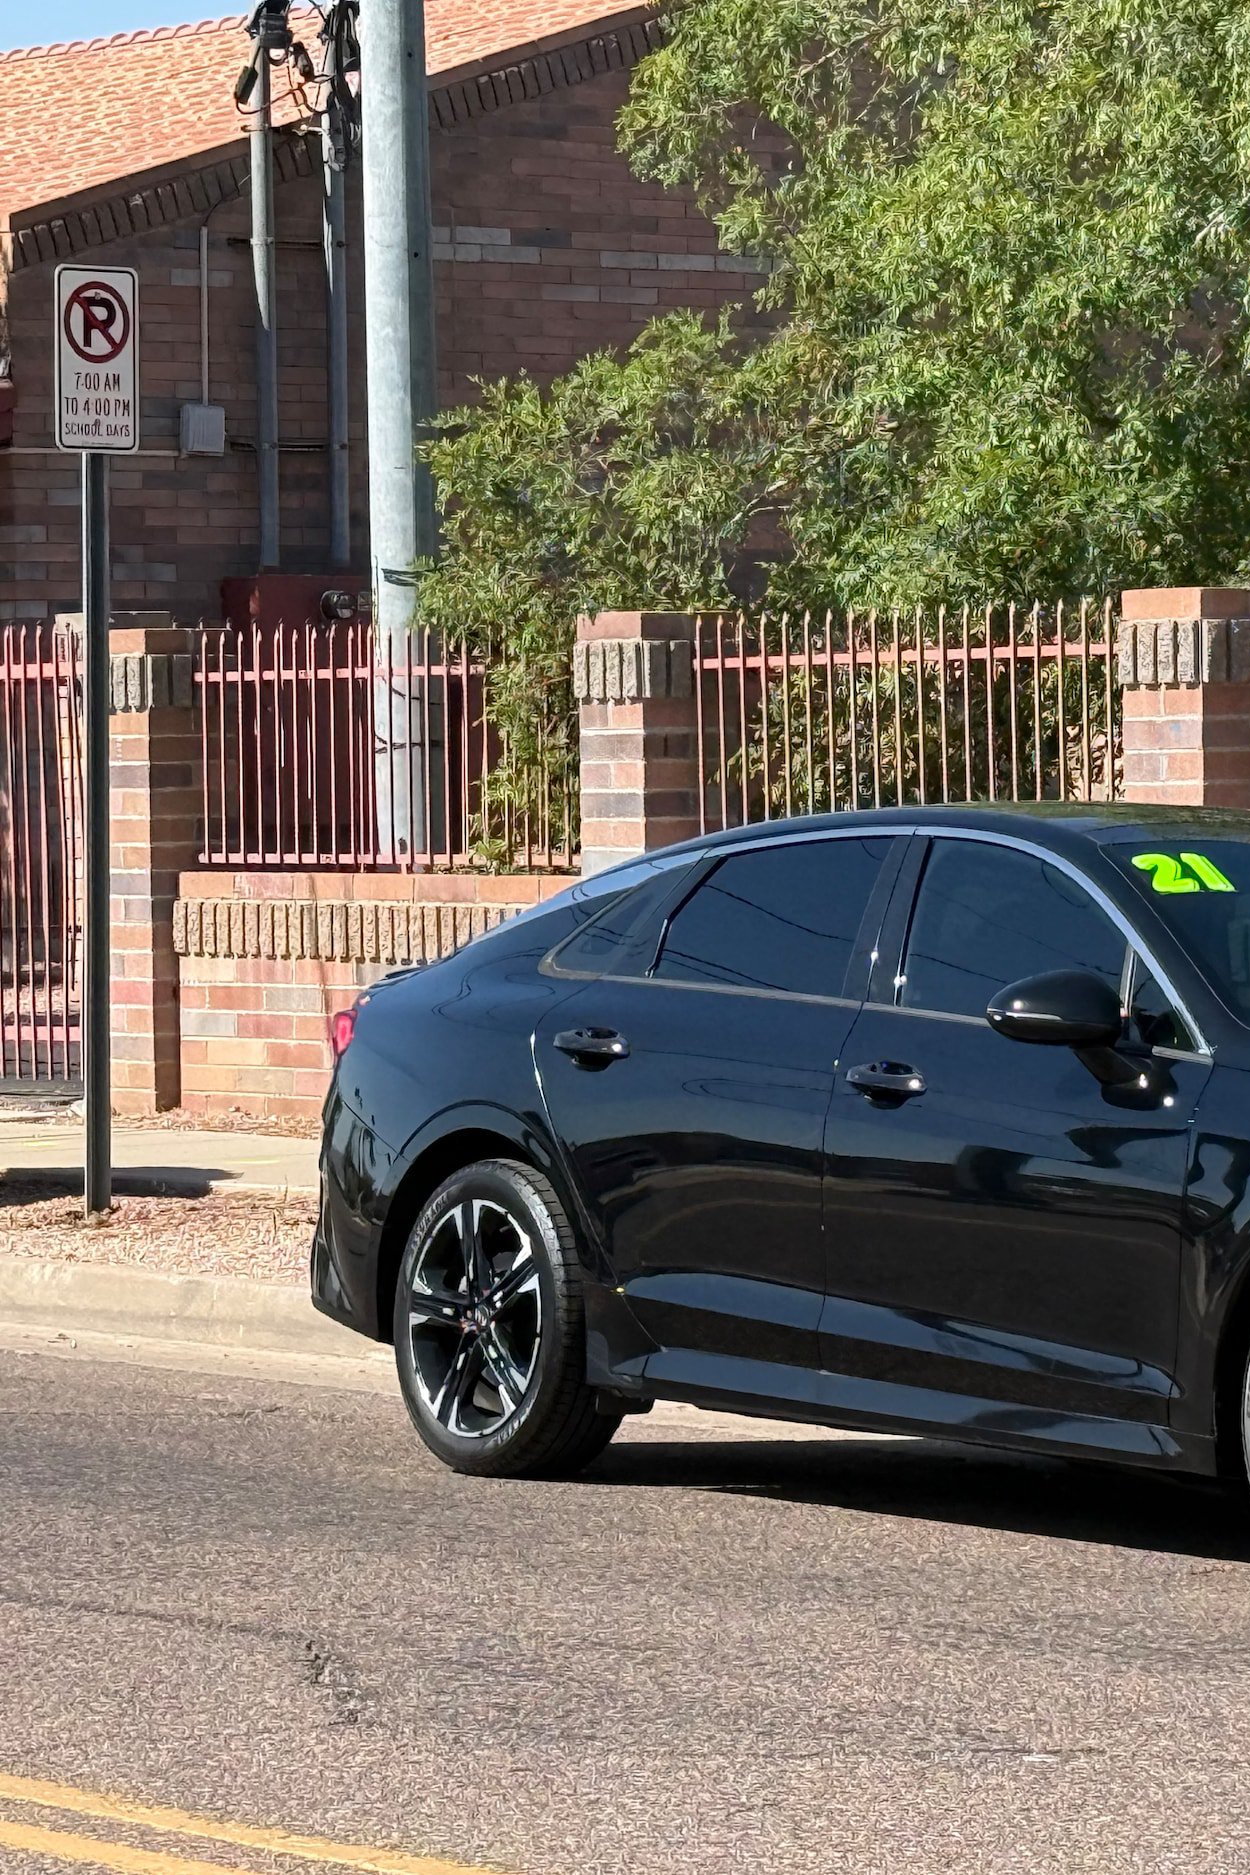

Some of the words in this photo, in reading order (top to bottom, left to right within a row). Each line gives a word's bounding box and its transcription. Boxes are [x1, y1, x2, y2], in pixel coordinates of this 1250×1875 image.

[104, 372, 121, 392] AM
[64, 396, 78, 416] TO
[114, 398, 130, 417] PM
[65, 422, 103, 438] SCHOOL
[106, 423, 131, 438] DAYS
[1131, 852, 1238, 894] 21
